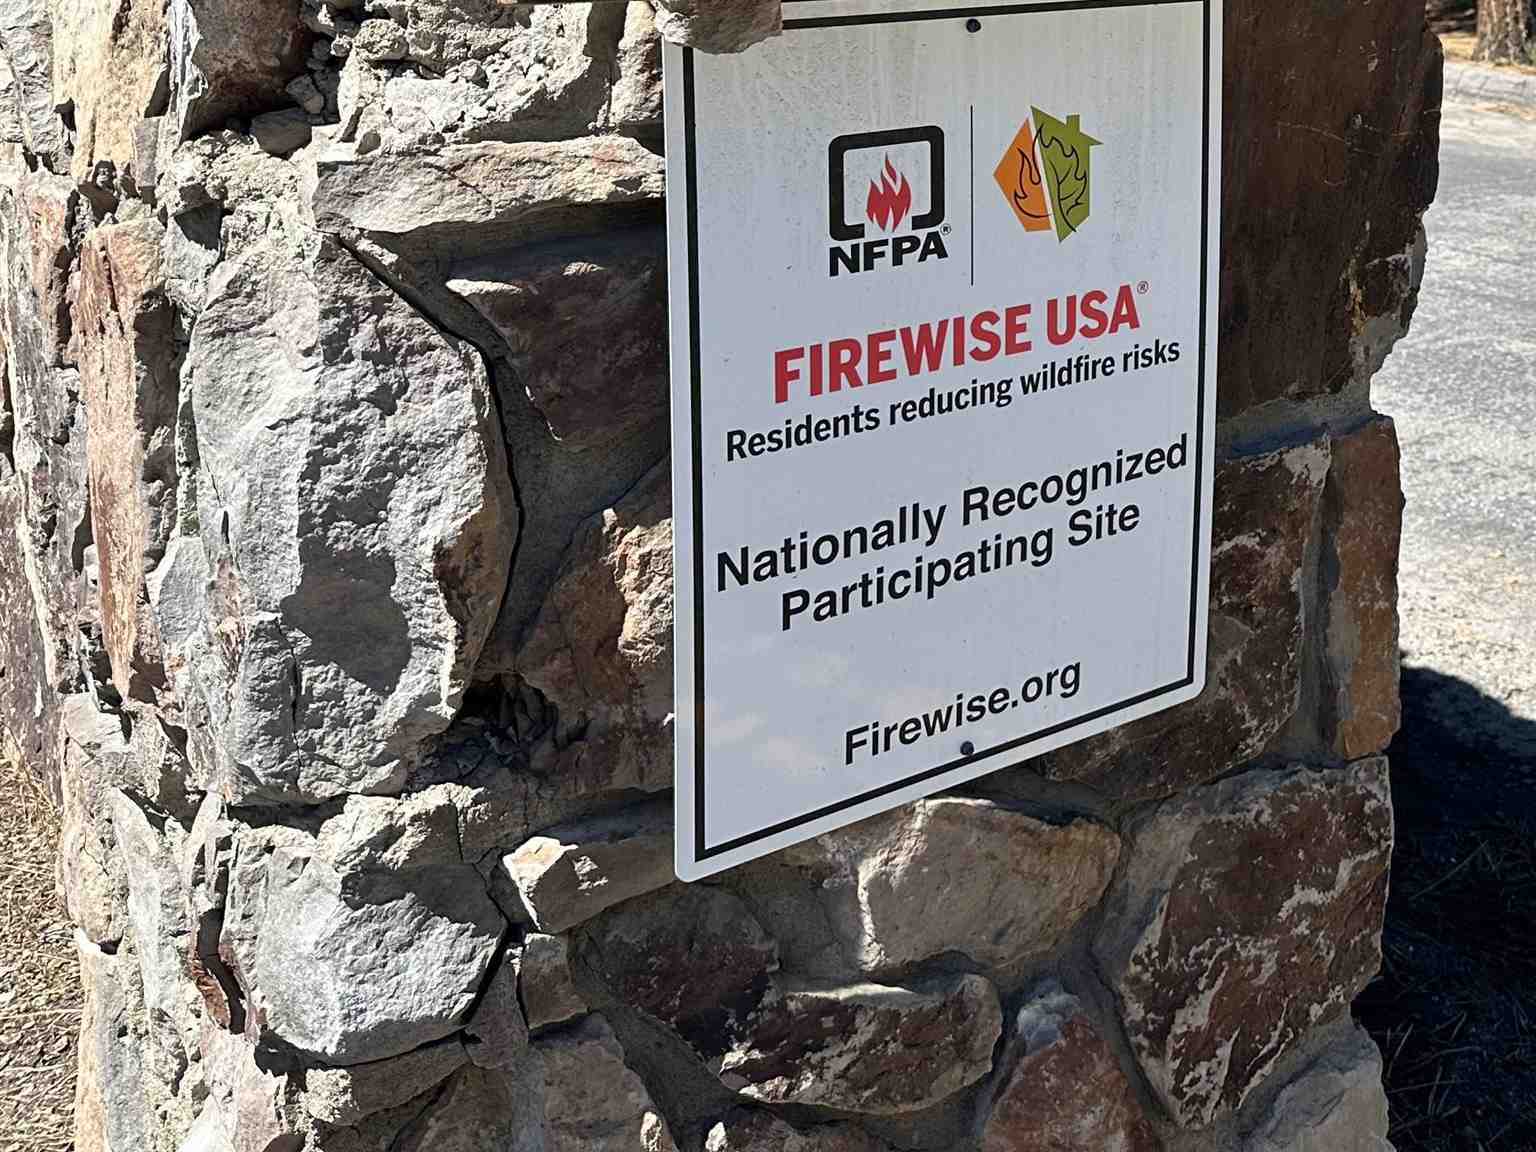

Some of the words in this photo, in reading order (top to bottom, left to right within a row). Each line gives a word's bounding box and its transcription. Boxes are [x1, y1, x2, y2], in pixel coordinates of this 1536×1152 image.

[726, 403, 880, 463] Residents
[889, 377, 1013, 428] reducing
[1020, 355, 1115, 396] wildfire
[1122, 337, 1181, 372] risks
[773, 303, 1032, 404] FIREWISE
[717, 503, 947, 592] Nationally
[962, 433, 1188, 526] Recognized
[781, 527, 1054, 631] Participating
[1068, 503, 1141, 547] Site
[845, 661, 1081, 765] Firewise.org
